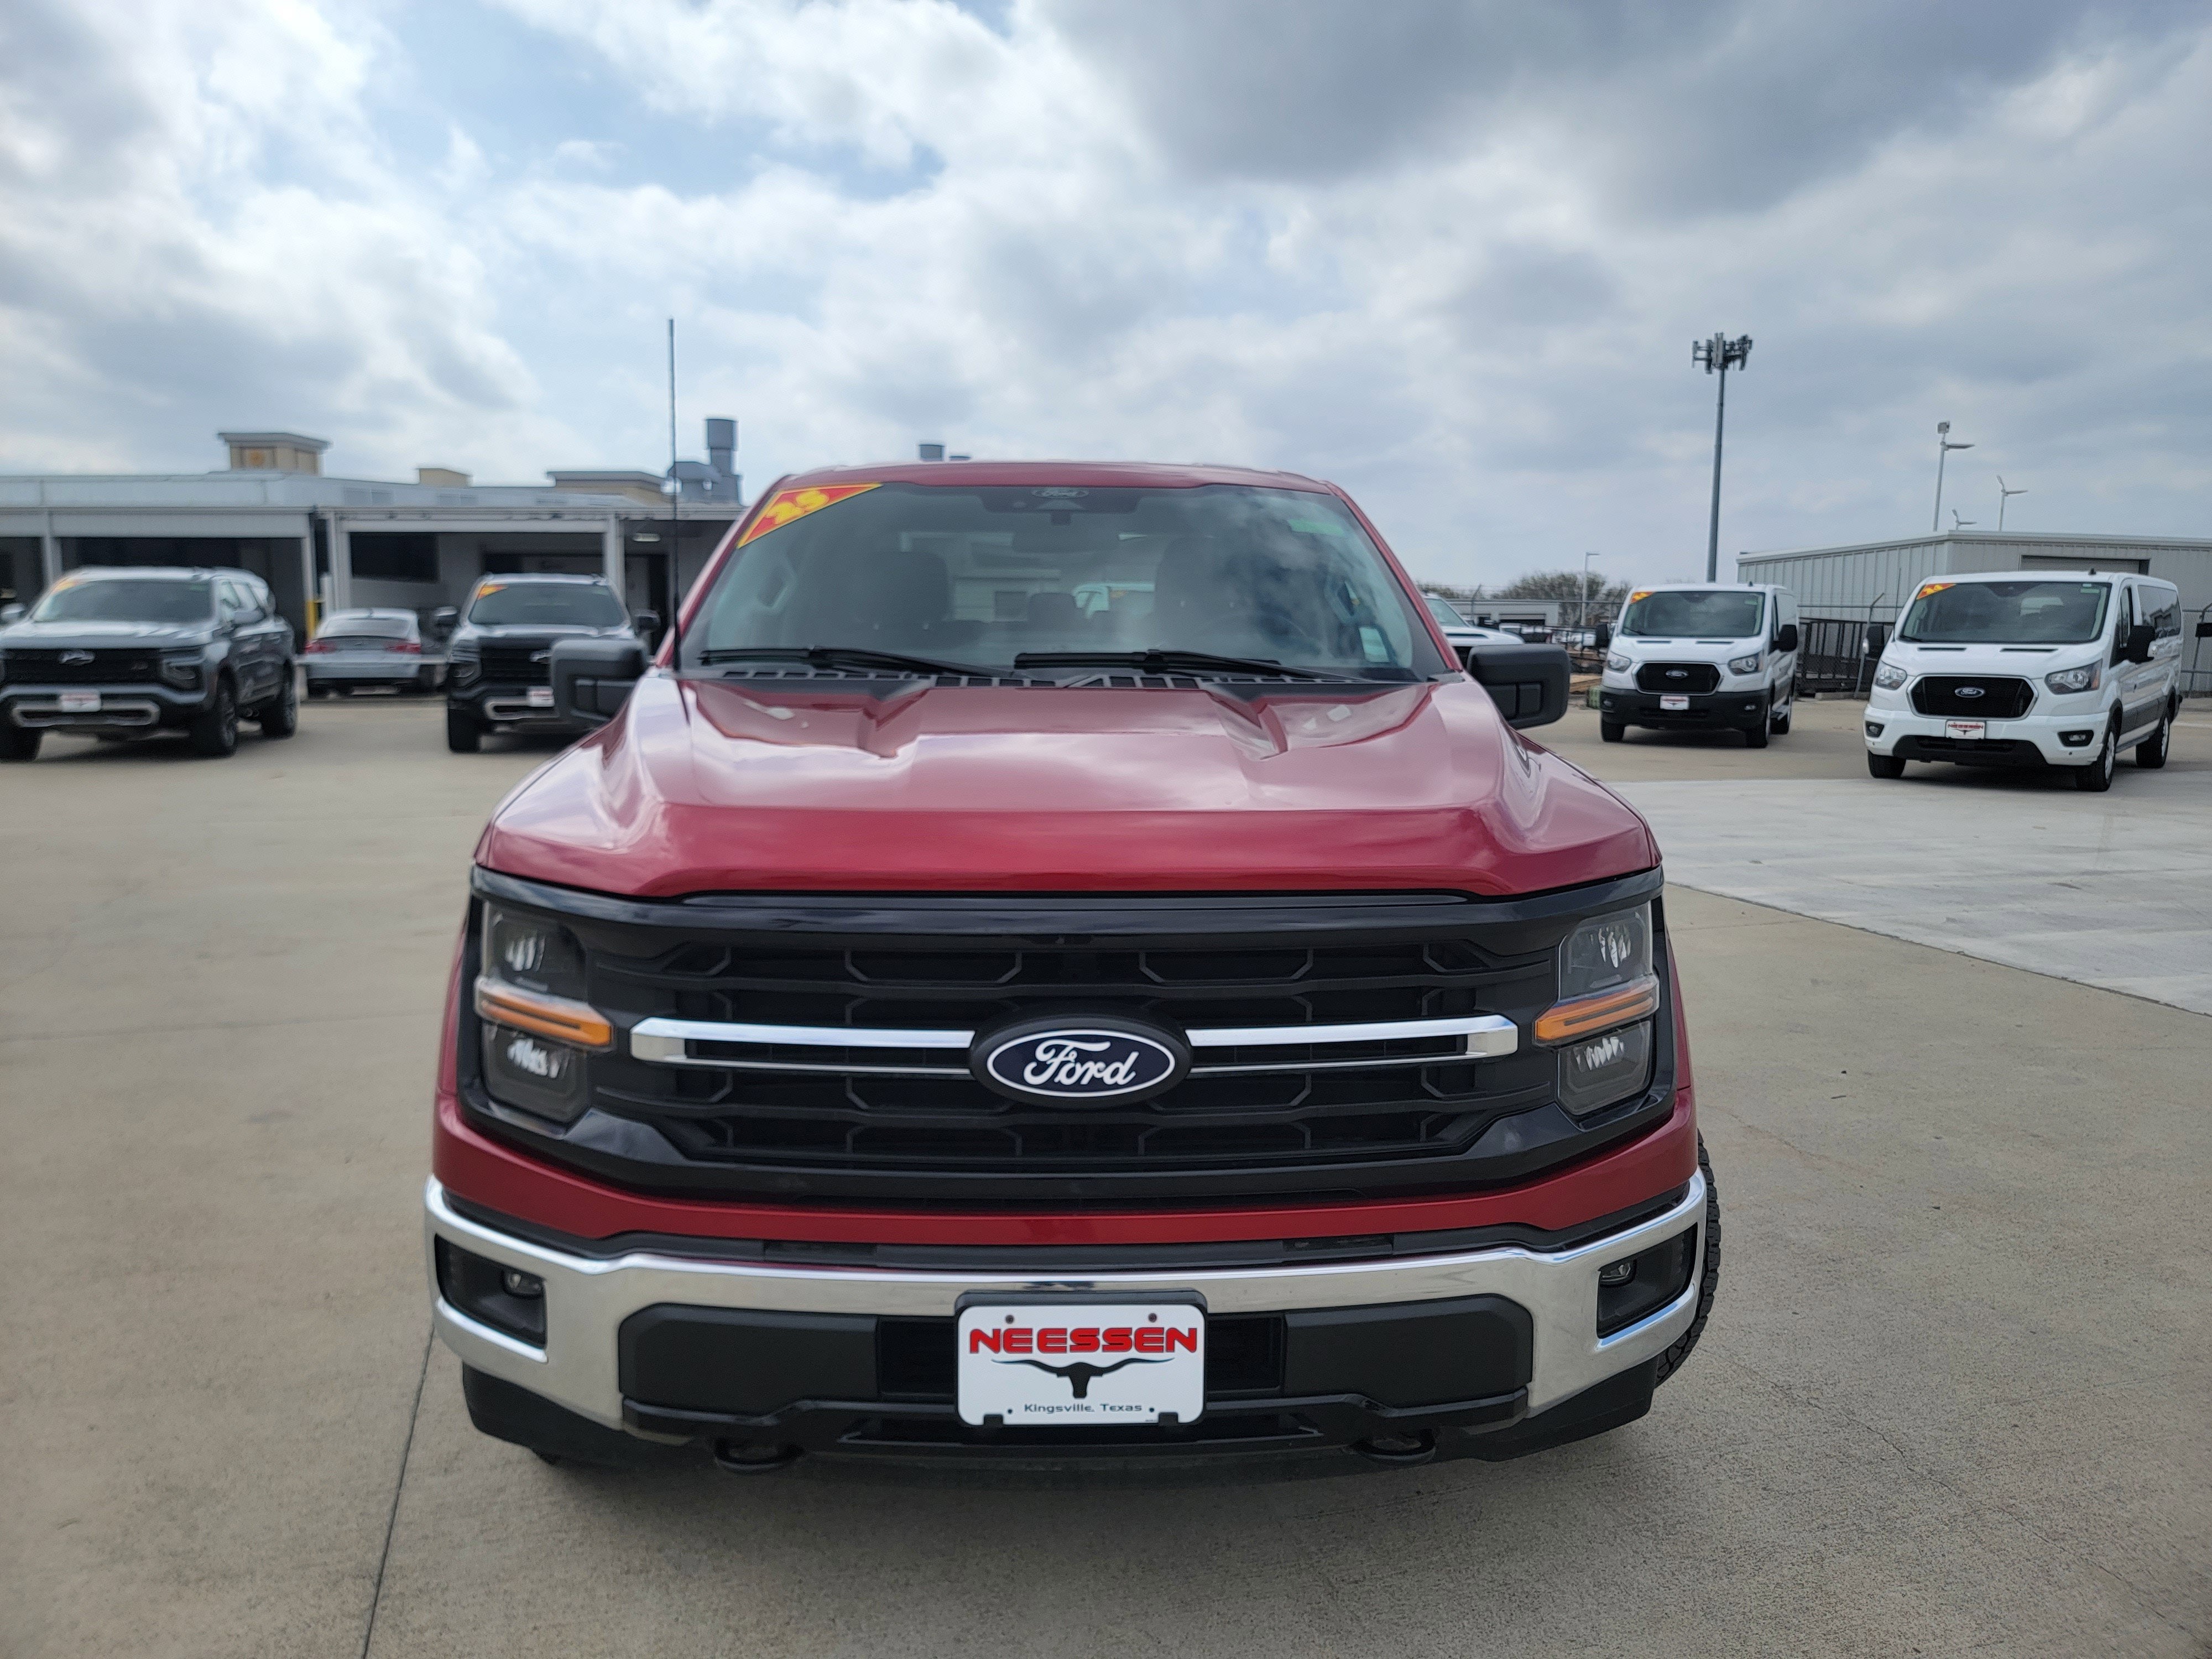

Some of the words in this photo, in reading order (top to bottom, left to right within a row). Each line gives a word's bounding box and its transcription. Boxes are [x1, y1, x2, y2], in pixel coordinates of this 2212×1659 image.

[764, 487, 830, 525] 25
[1023, 1038, 1140, 1086] Ford
[969, 1327, 1197, 1354] NEESSEN
[1099, 1403, 1142, 1412] Texas
